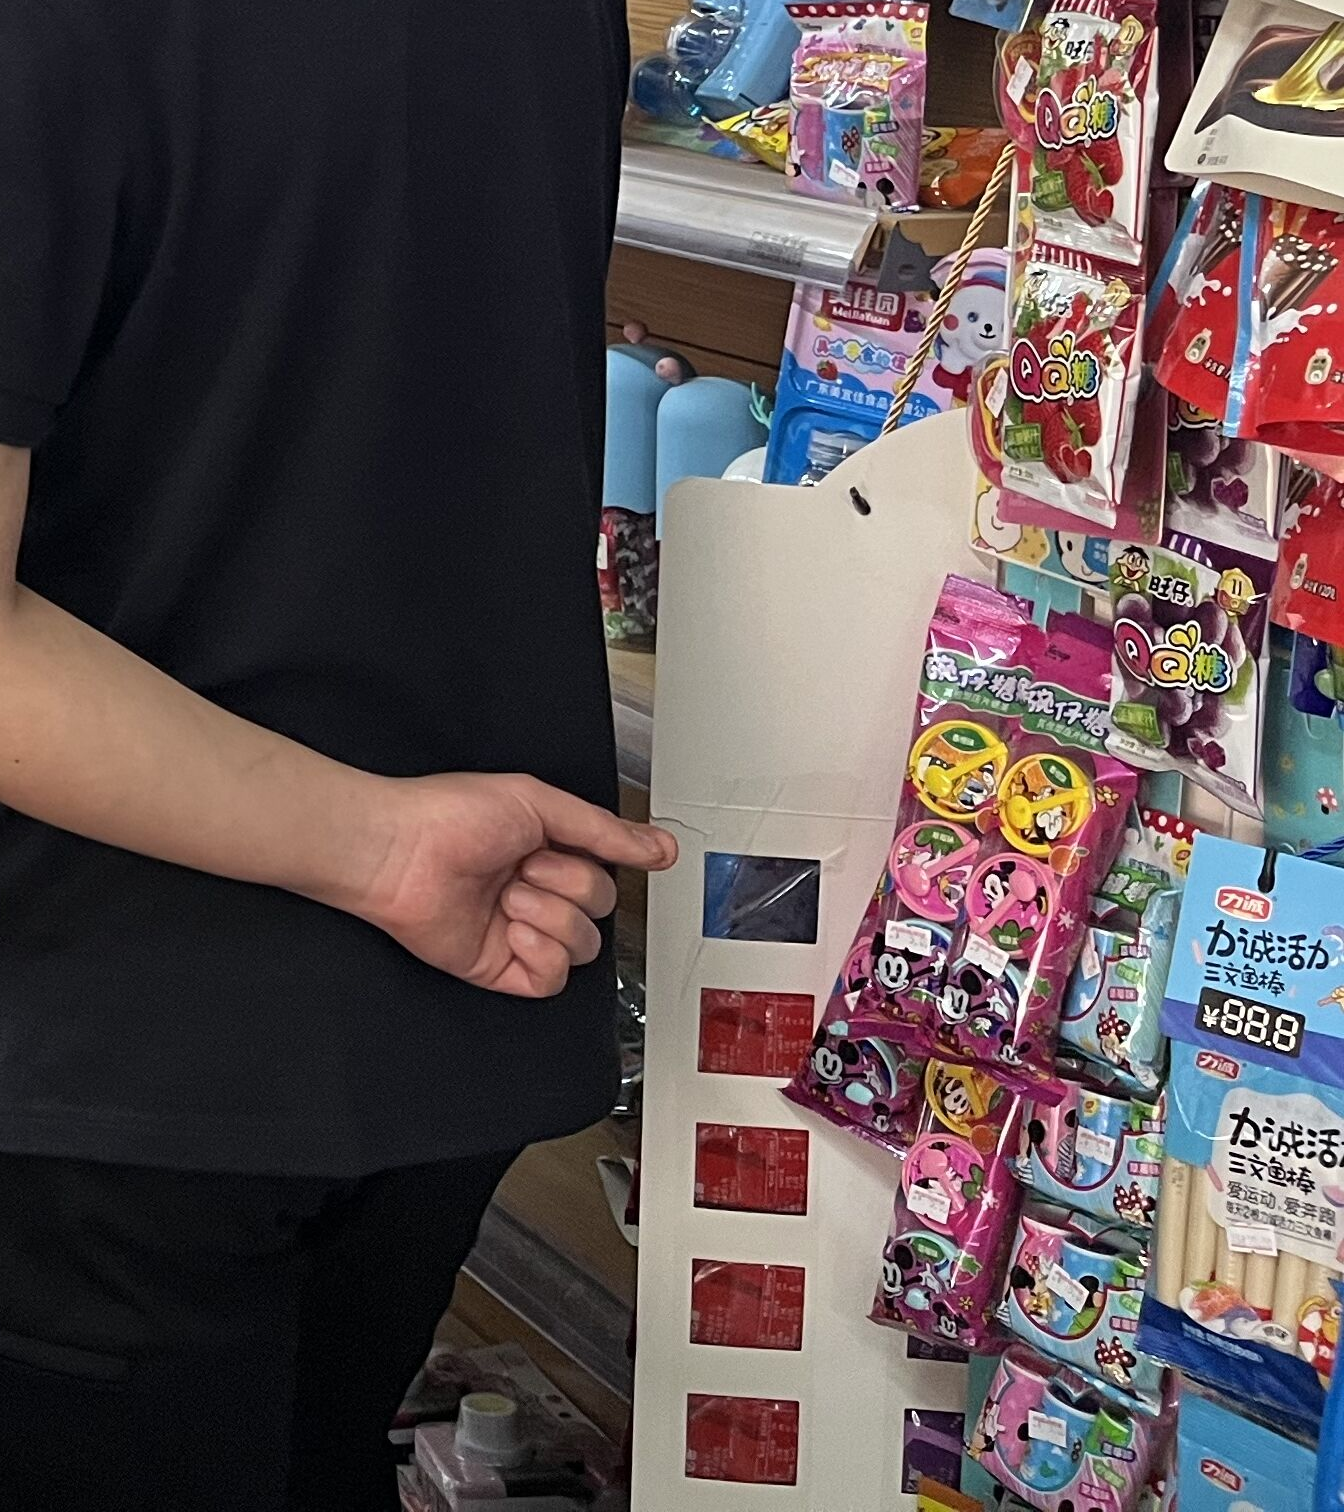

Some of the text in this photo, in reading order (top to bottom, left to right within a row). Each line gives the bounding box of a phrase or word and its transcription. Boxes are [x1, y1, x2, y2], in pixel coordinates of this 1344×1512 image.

[1036, 90, 1117, 146] QQ糖
[1012, 339, 1099, 398] QQ糖
[1149, 575, 1190, 603] 旺仔
[1115, 620, 1229, 688] QQ糖
[1223, 892, 1265, 915] 力诚
[1206, 920, 1329, 970] 力诚活力
[1204, 962, 1285, 997] 三文鱼棒
[1202, 998, 1299, 1052] ¥88.8
[1229, 1107, 1344, 1168] 力诚活
[1229, 1151, 1315, 1195] 三文鱼棒
